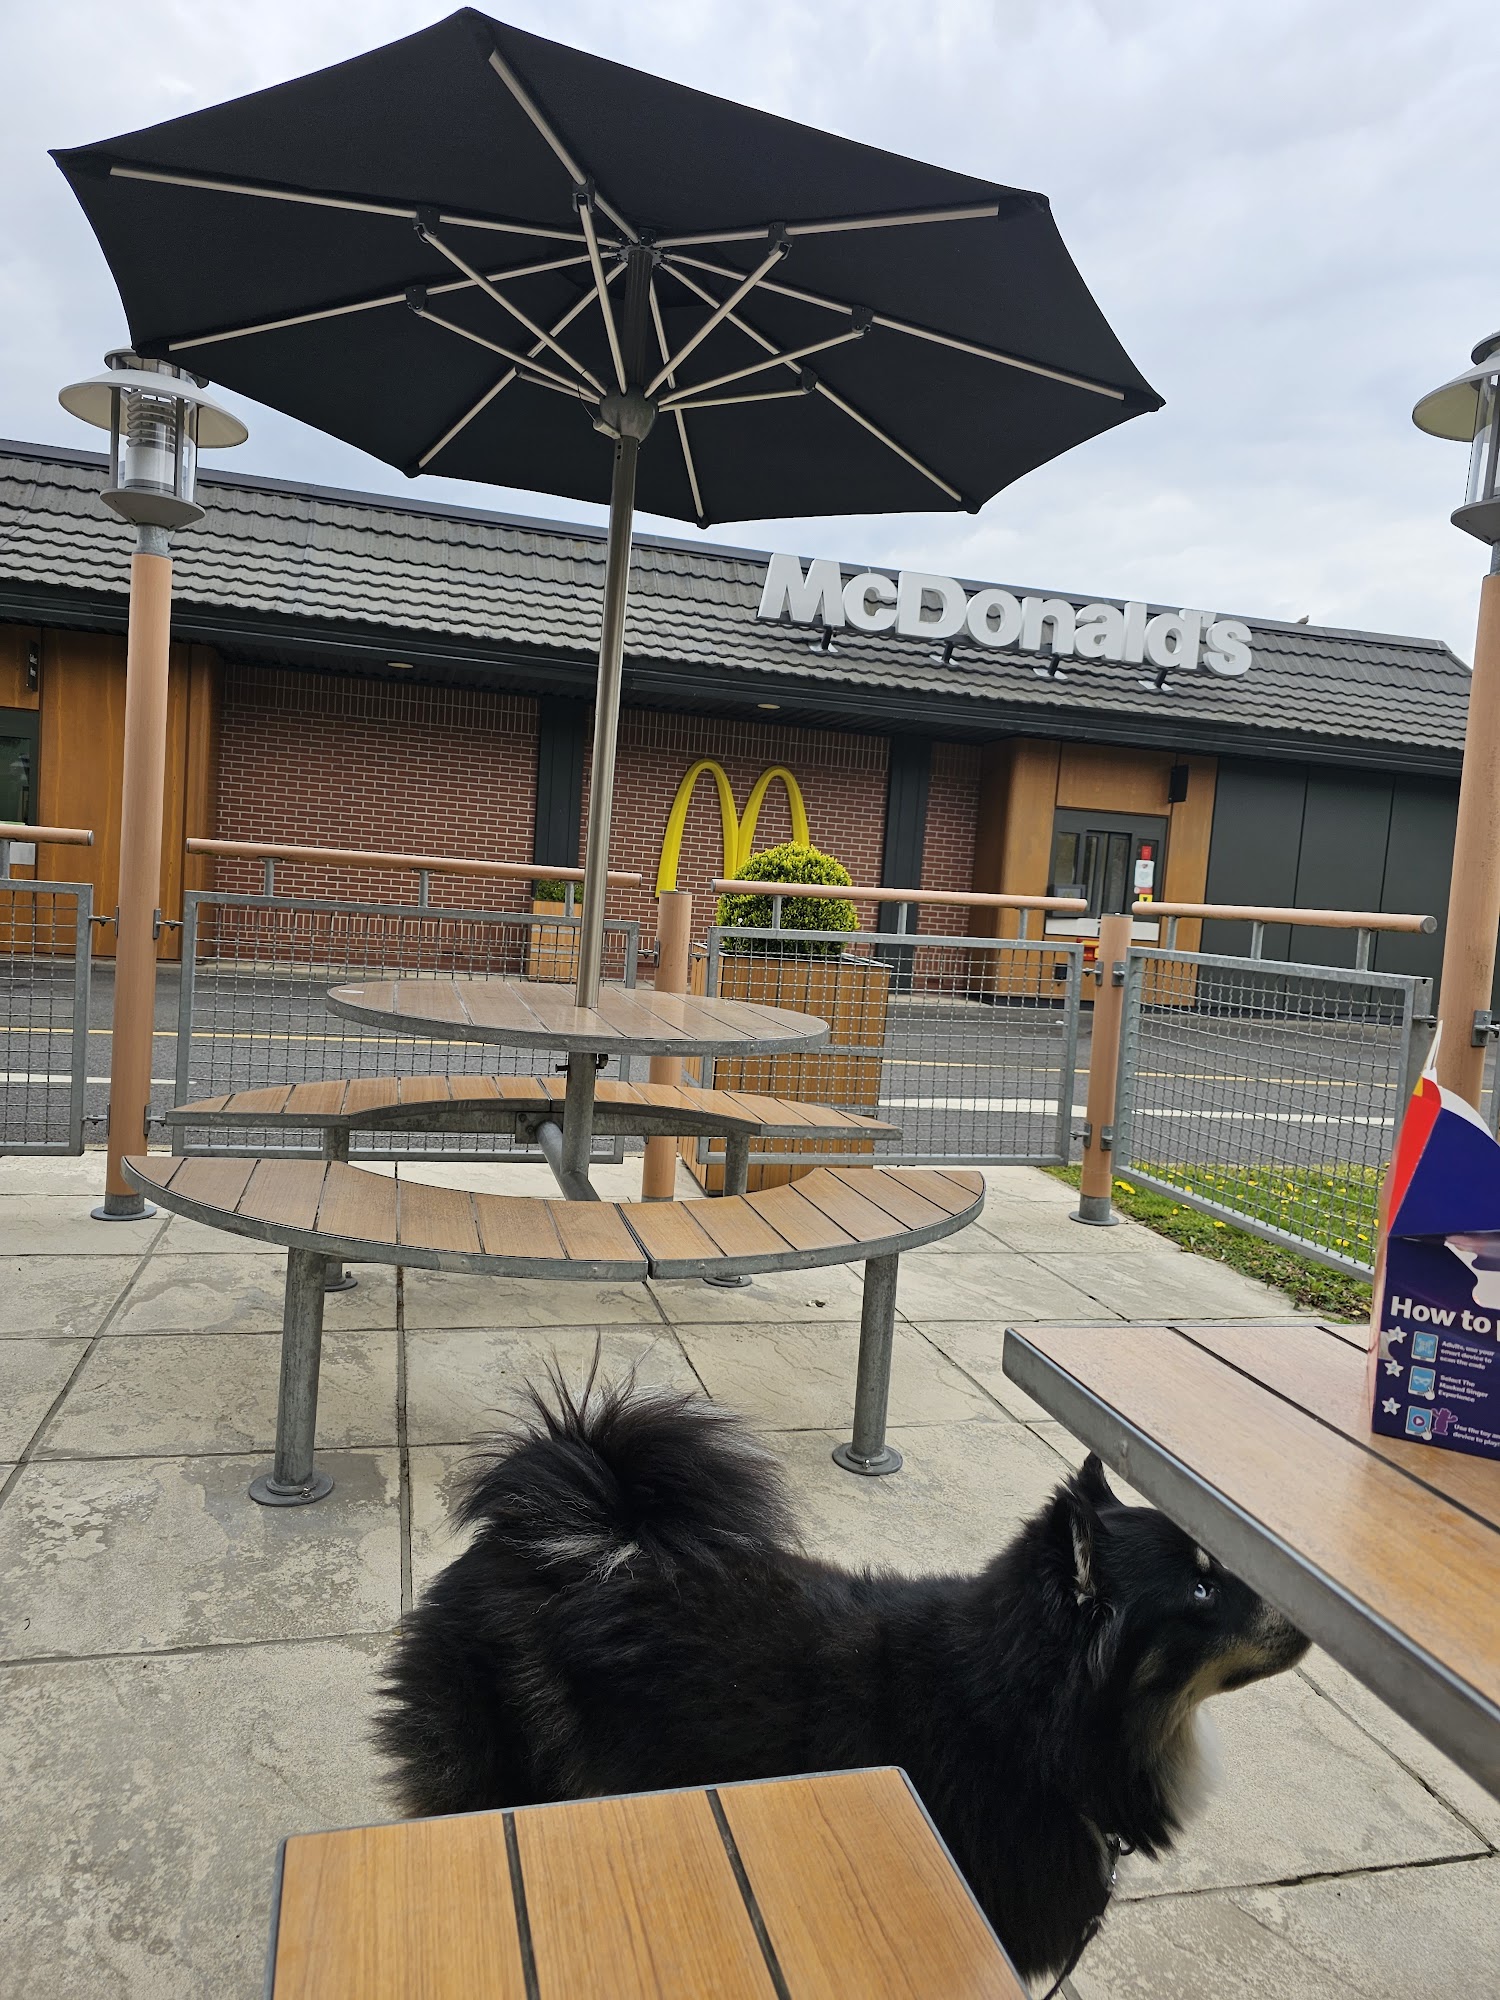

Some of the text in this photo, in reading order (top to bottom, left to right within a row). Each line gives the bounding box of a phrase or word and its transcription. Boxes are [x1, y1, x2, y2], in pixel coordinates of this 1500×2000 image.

[757, 552, 1252, 676] McDonald's
[1390, 1295, 1456, 1327] How
[1461, 1310, 1492, 1334] to
[1440, 1349, 1460, 1357] smart
[1460, 1352, 1484, 1361] device
[1441, 1340, 1465, 1351] Adults,
[1478, 1349, 1496, 1357] your
[1468, 1362, 1486, 1370] code
[1440, 1374, 1475, 1387] Select The
[1438, 1389, 1475, 1403] Experience
[1439, 1382, 1489, 1398] Masked Singer
[1452, 1431, 1475, 1442] device
[1454, 1423, 1467, 1432] Use
[1467, 1426, 1480, 1435] the
[1480, 1429, 1491, 1438] toy
